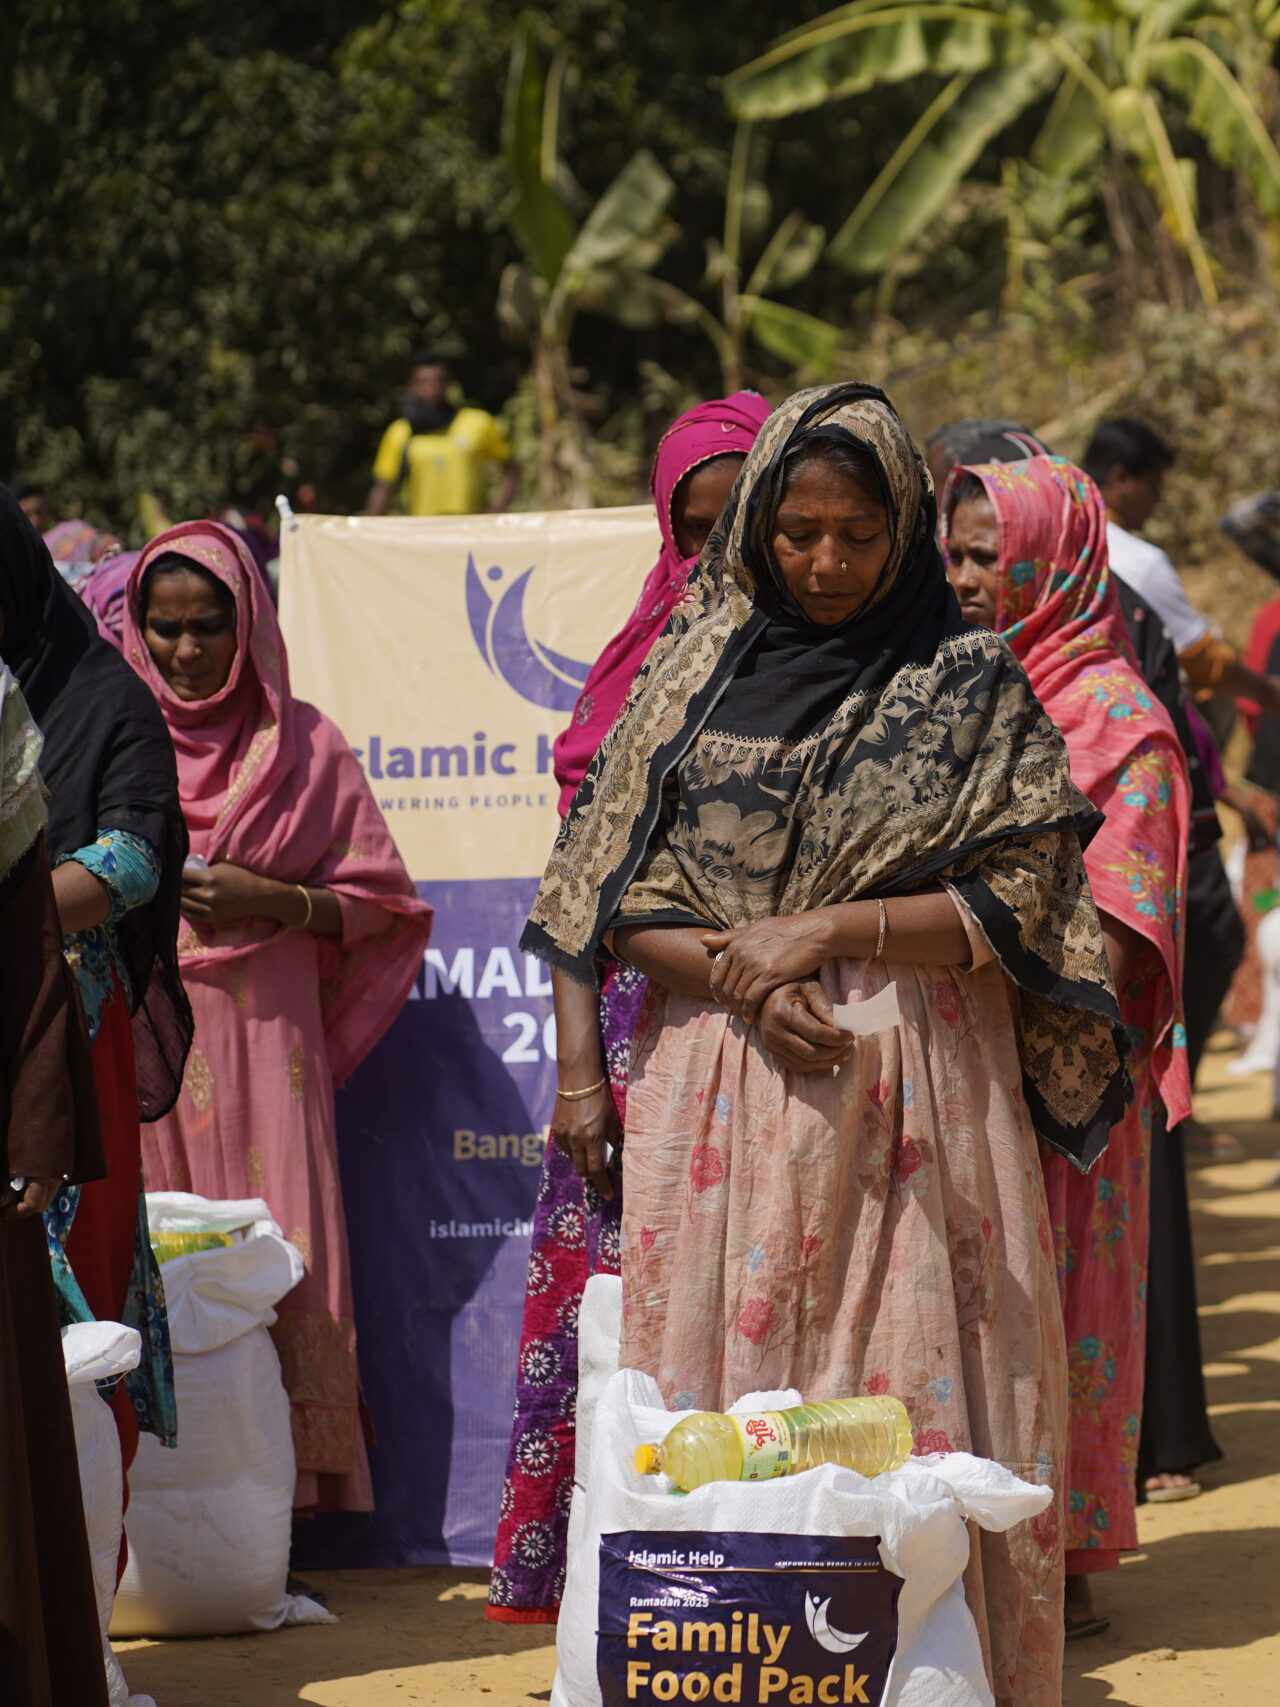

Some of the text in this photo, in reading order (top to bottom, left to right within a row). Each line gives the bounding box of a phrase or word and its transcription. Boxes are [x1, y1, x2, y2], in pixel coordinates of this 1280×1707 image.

[380, 793, 547, 811] WERING PEOPLE
[628, 1549, 725, 1567] Islamic Help
[629, 1596, 710, 1608] Ramadan 2025
[627, 1611, 792, 1664] Family
[626, 1661, 871, 1705] Food Pack
